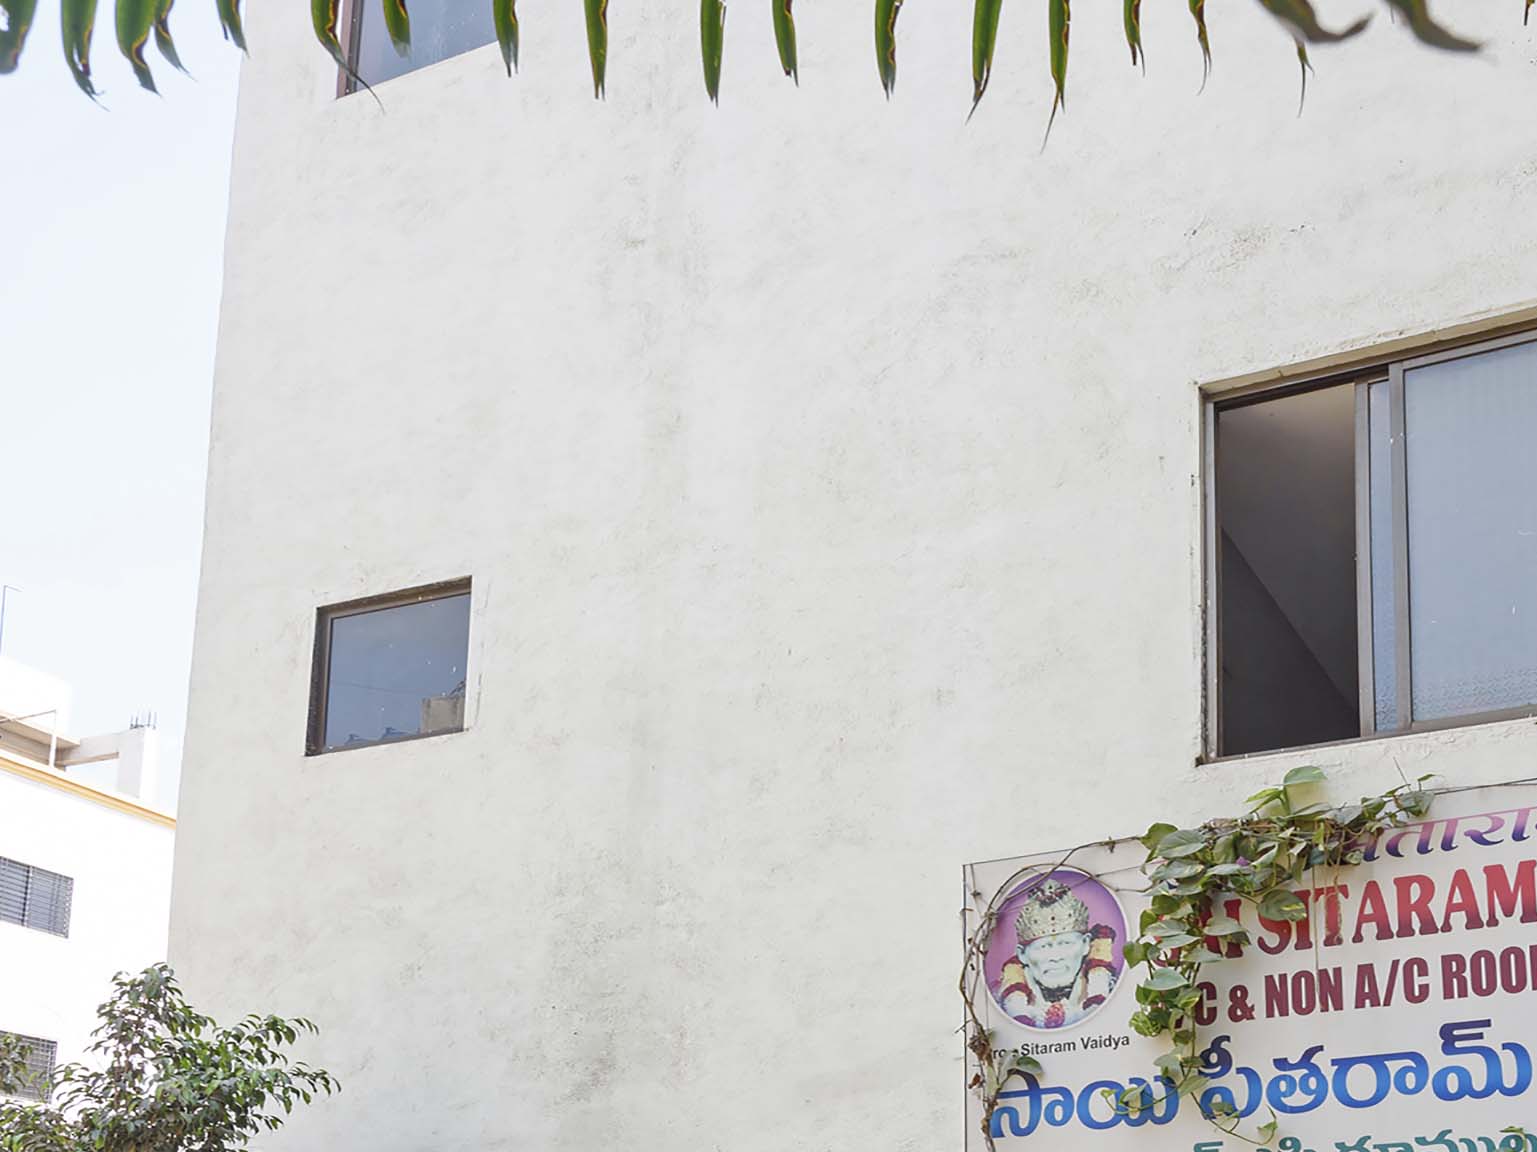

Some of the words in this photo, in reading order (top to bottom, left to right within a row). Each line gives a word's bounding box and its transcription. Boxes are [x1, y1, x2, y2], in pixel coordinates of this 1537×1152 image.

[1227, 984, 1256, 1023] &
[1264, 966, 1344, 1019] NON
[1354, 956, 1430, 1011] A/C
[1021, 1040, 1077, 1057] Sitaram
[1080, 1034, 1131, 1051] Vaidya
